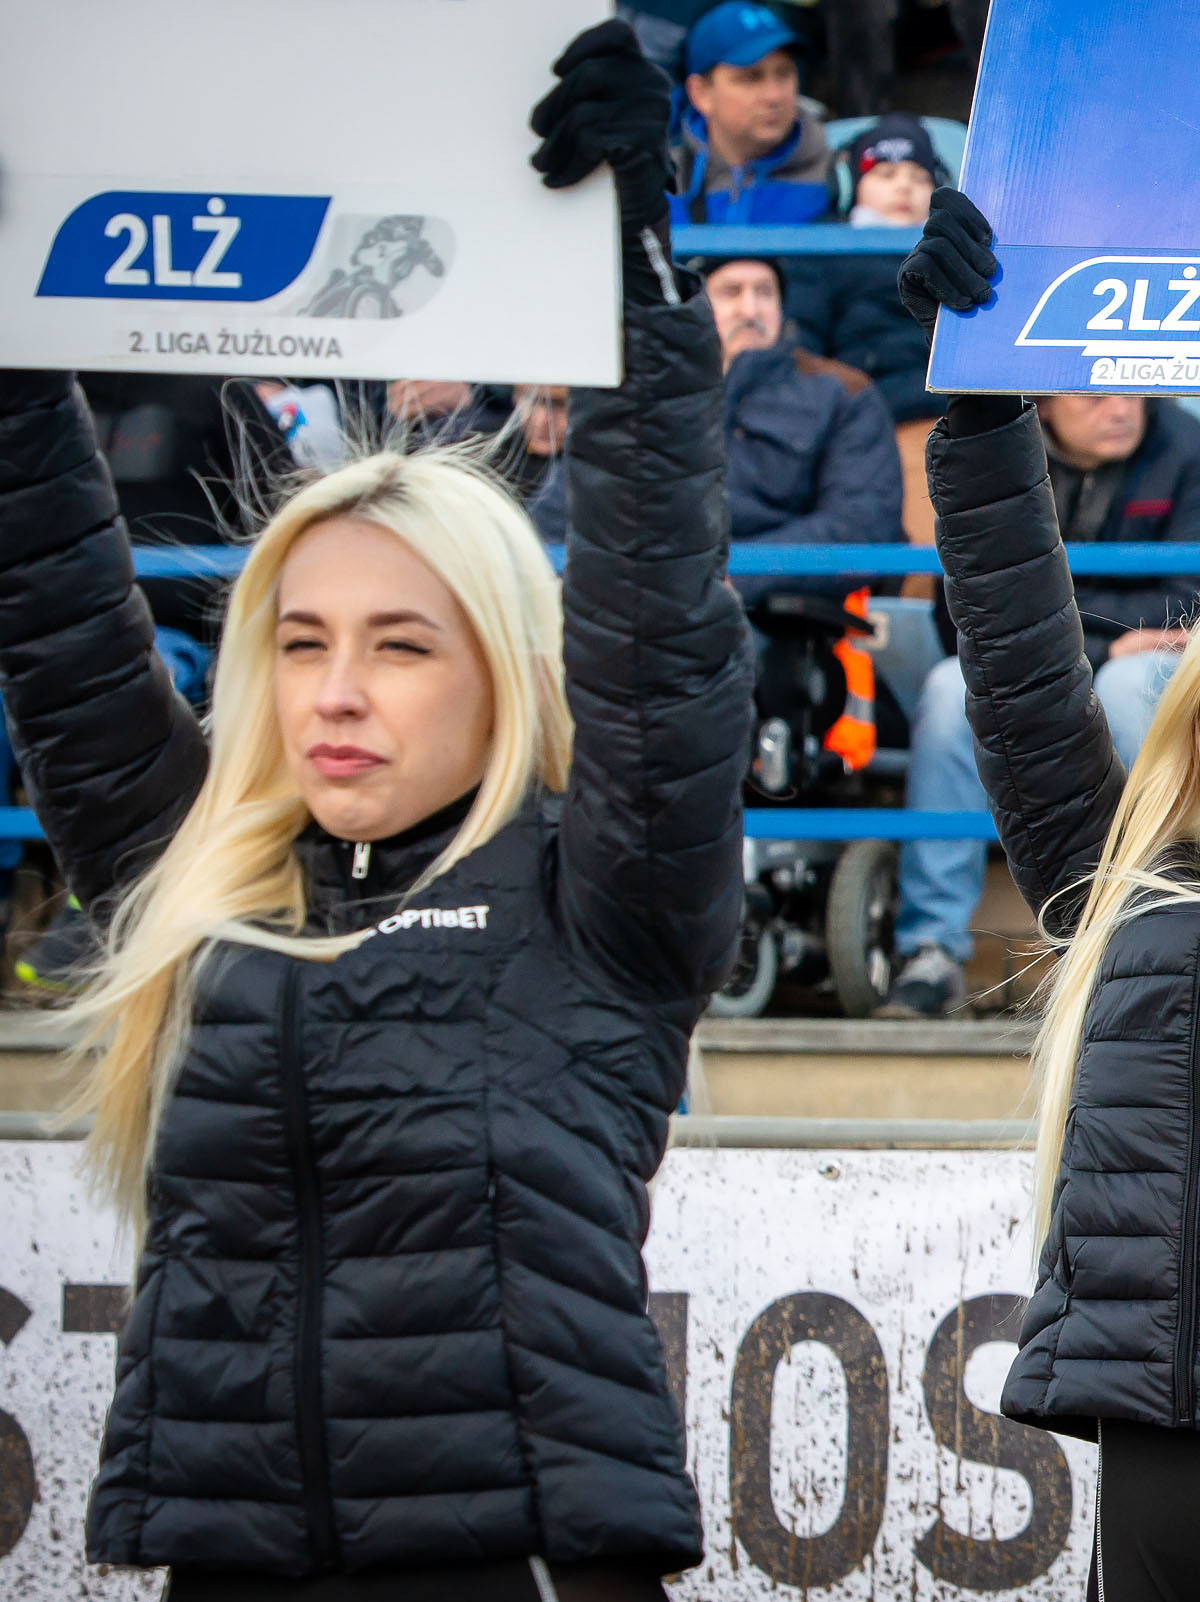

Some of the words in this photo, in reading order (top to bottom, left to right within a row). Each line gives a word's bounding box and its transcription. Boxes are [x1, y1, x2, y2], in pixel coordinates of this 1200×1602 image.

[103, 197, 242, 289] 2LŻ
[155, 331, 212, 355] LIGA
[216, 328, 343, 359] ŻUŻLOWA
[1120, 363, 1167, 380] LIGA
[377, 905, 490, 935] OPTIBET
